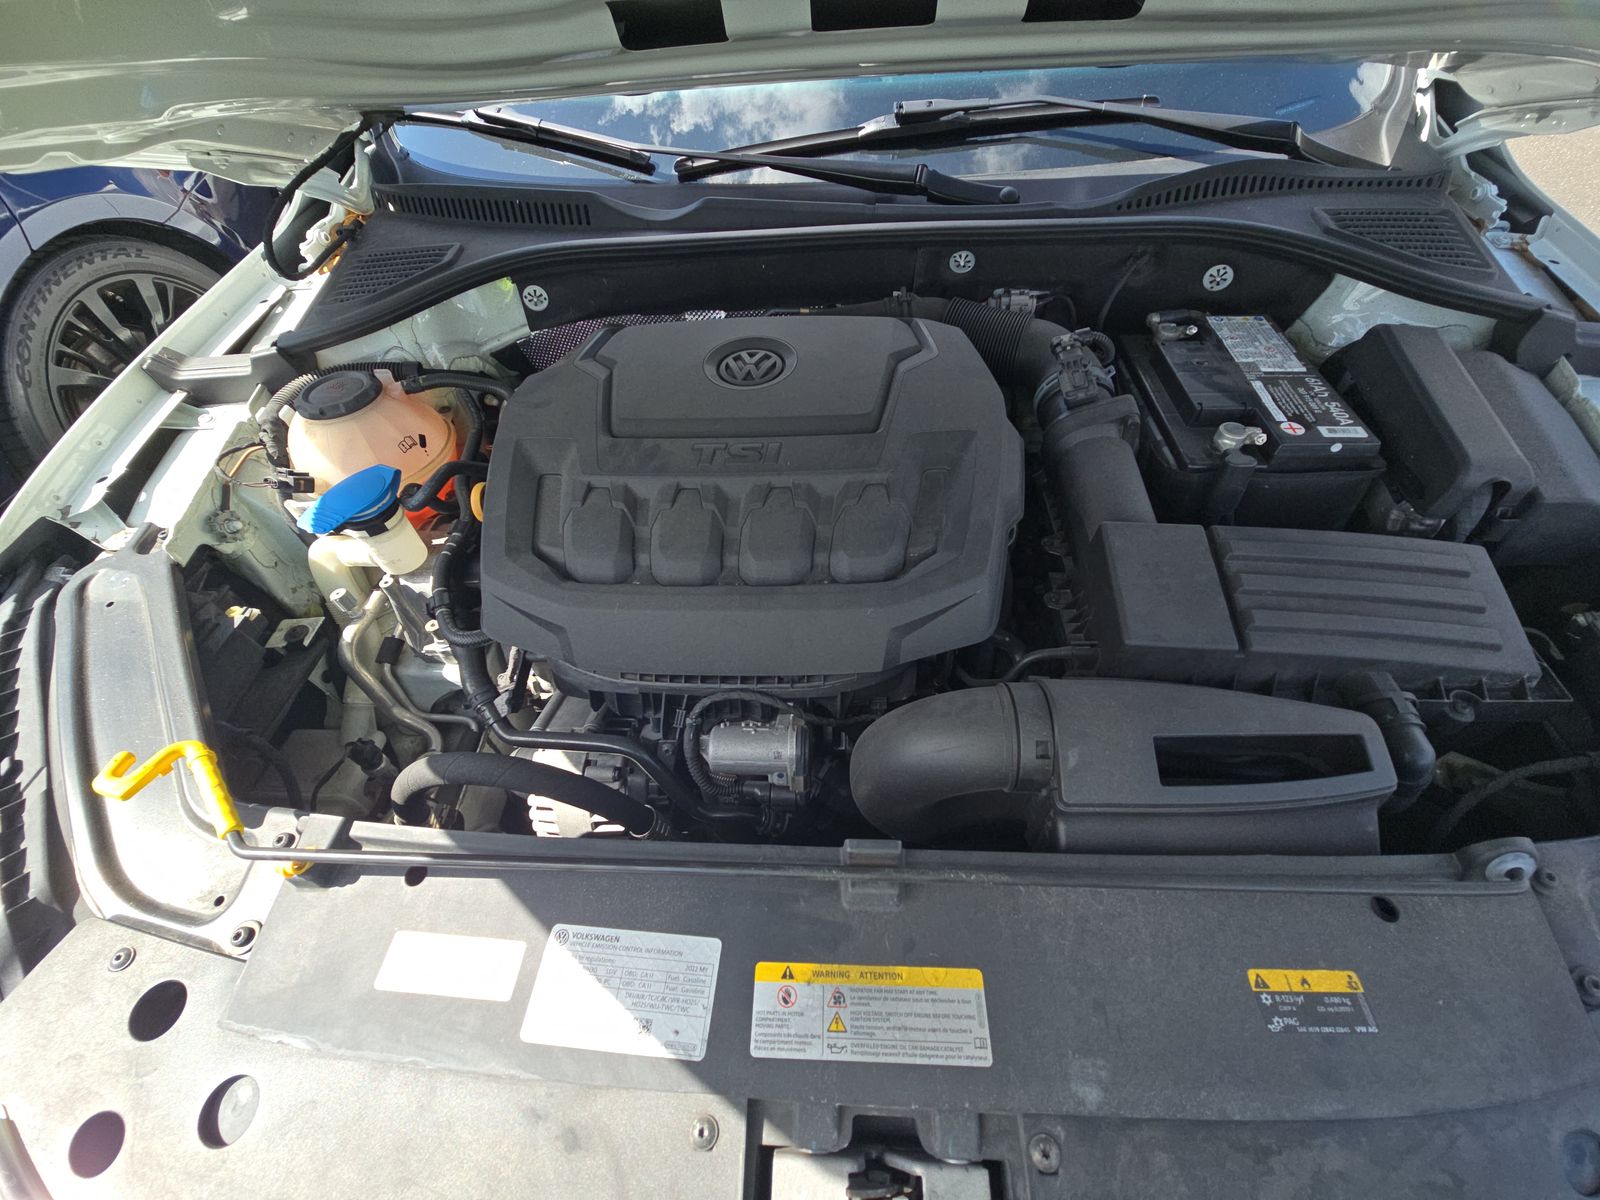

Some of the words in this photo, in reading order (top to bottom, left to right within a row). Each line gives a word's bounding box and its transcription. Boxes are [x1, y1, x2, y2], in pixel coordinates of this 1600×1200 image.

[15, 247, 150, 390] CONTINENTAL
[1305, 377, 1330, 398] 61Ah
[1324, 401, 1354, 426] 540A
[691, 442, 783, 465] TSI
[571, 931, 621, 943] VOLKSWAGEN
[591, 943, 618, 951] EMISSION
[618, 945, 643, 953] CONTROL
[644, 948, 683, 957] INFORMATION
[684, 965, 698, 973] 2022
[683, 975, 706, 984] Gasoline
[812, 970, 850, 978] WARNING
[858, 971, 903, 980] ATTENTION
[681, 986, 705, 995] Gasoline
[1283, 1017, 1300, 1026] PAG
